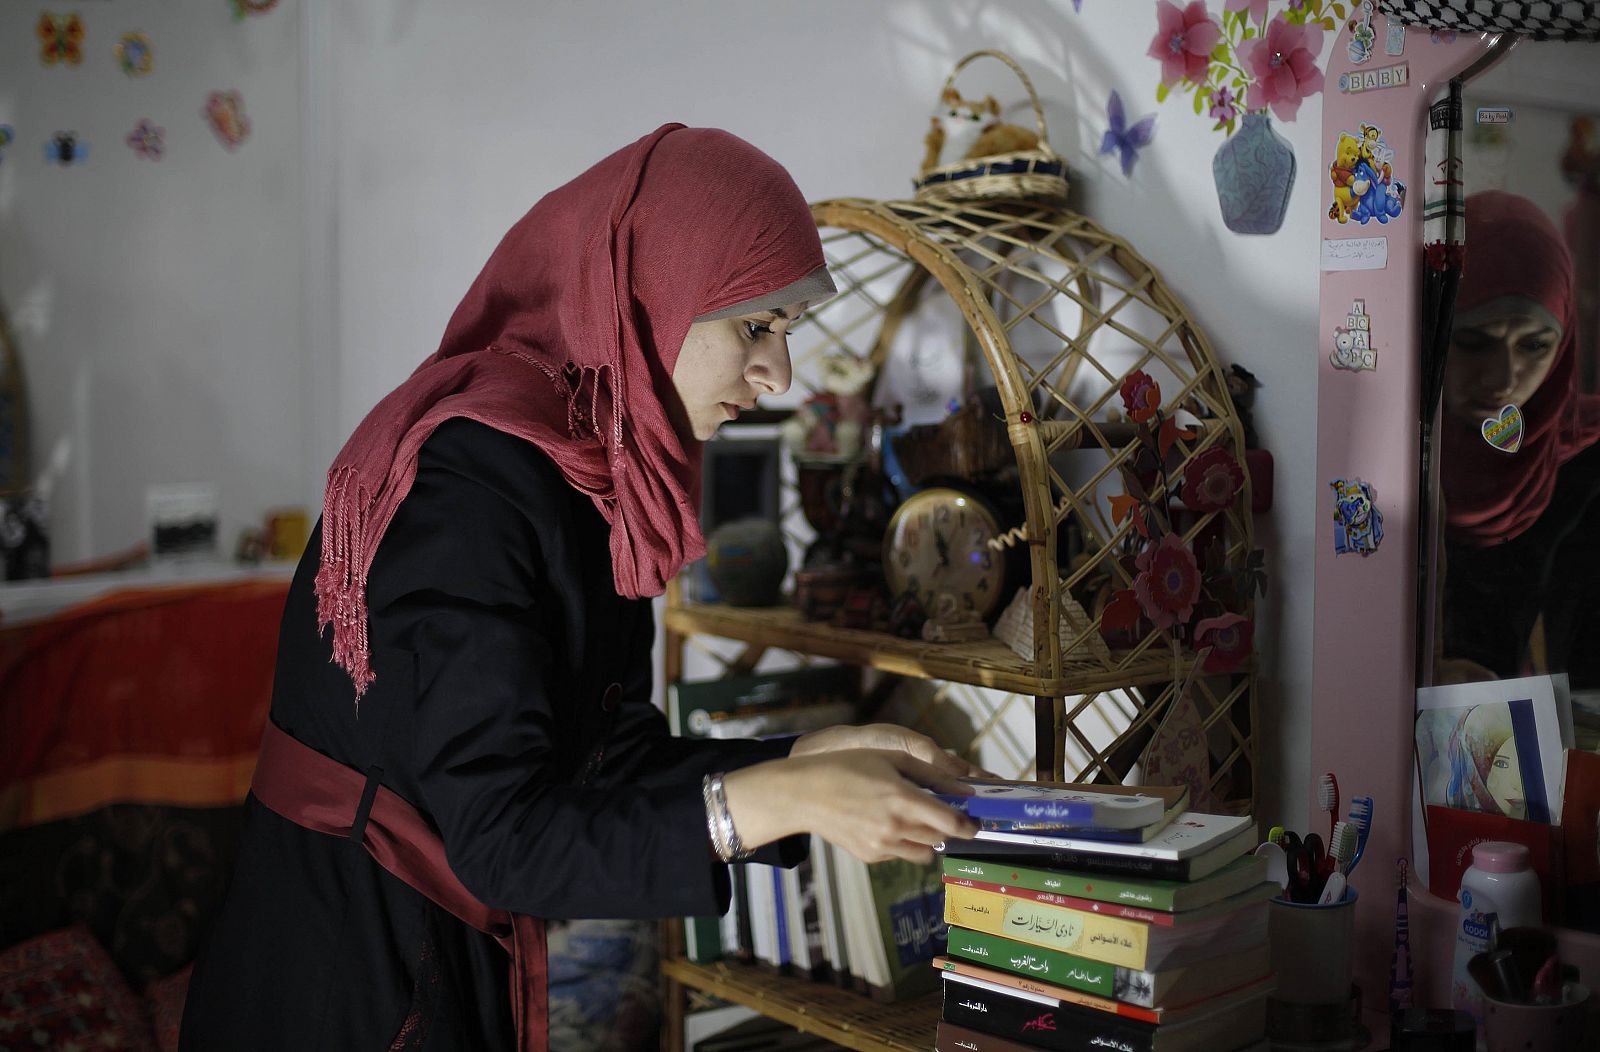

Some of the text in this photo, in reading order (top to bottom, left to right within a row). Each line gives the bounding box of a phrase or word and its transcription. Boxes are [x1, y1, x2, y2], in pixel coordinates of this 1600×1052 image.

[1351, 69, 1403, 89] BABY
[1354, 304, 1361, 314] A
[1357, 334, 1365, 346] A
[964, 905, 983, 913] الشروق
[961, 945, 982, 955] الشروق
[1010, 955, 1049, 973] واحة الغروب
[1066, 968, 1084, 980] طاهر
[958, 999, 988, 1013] دار الشروق
